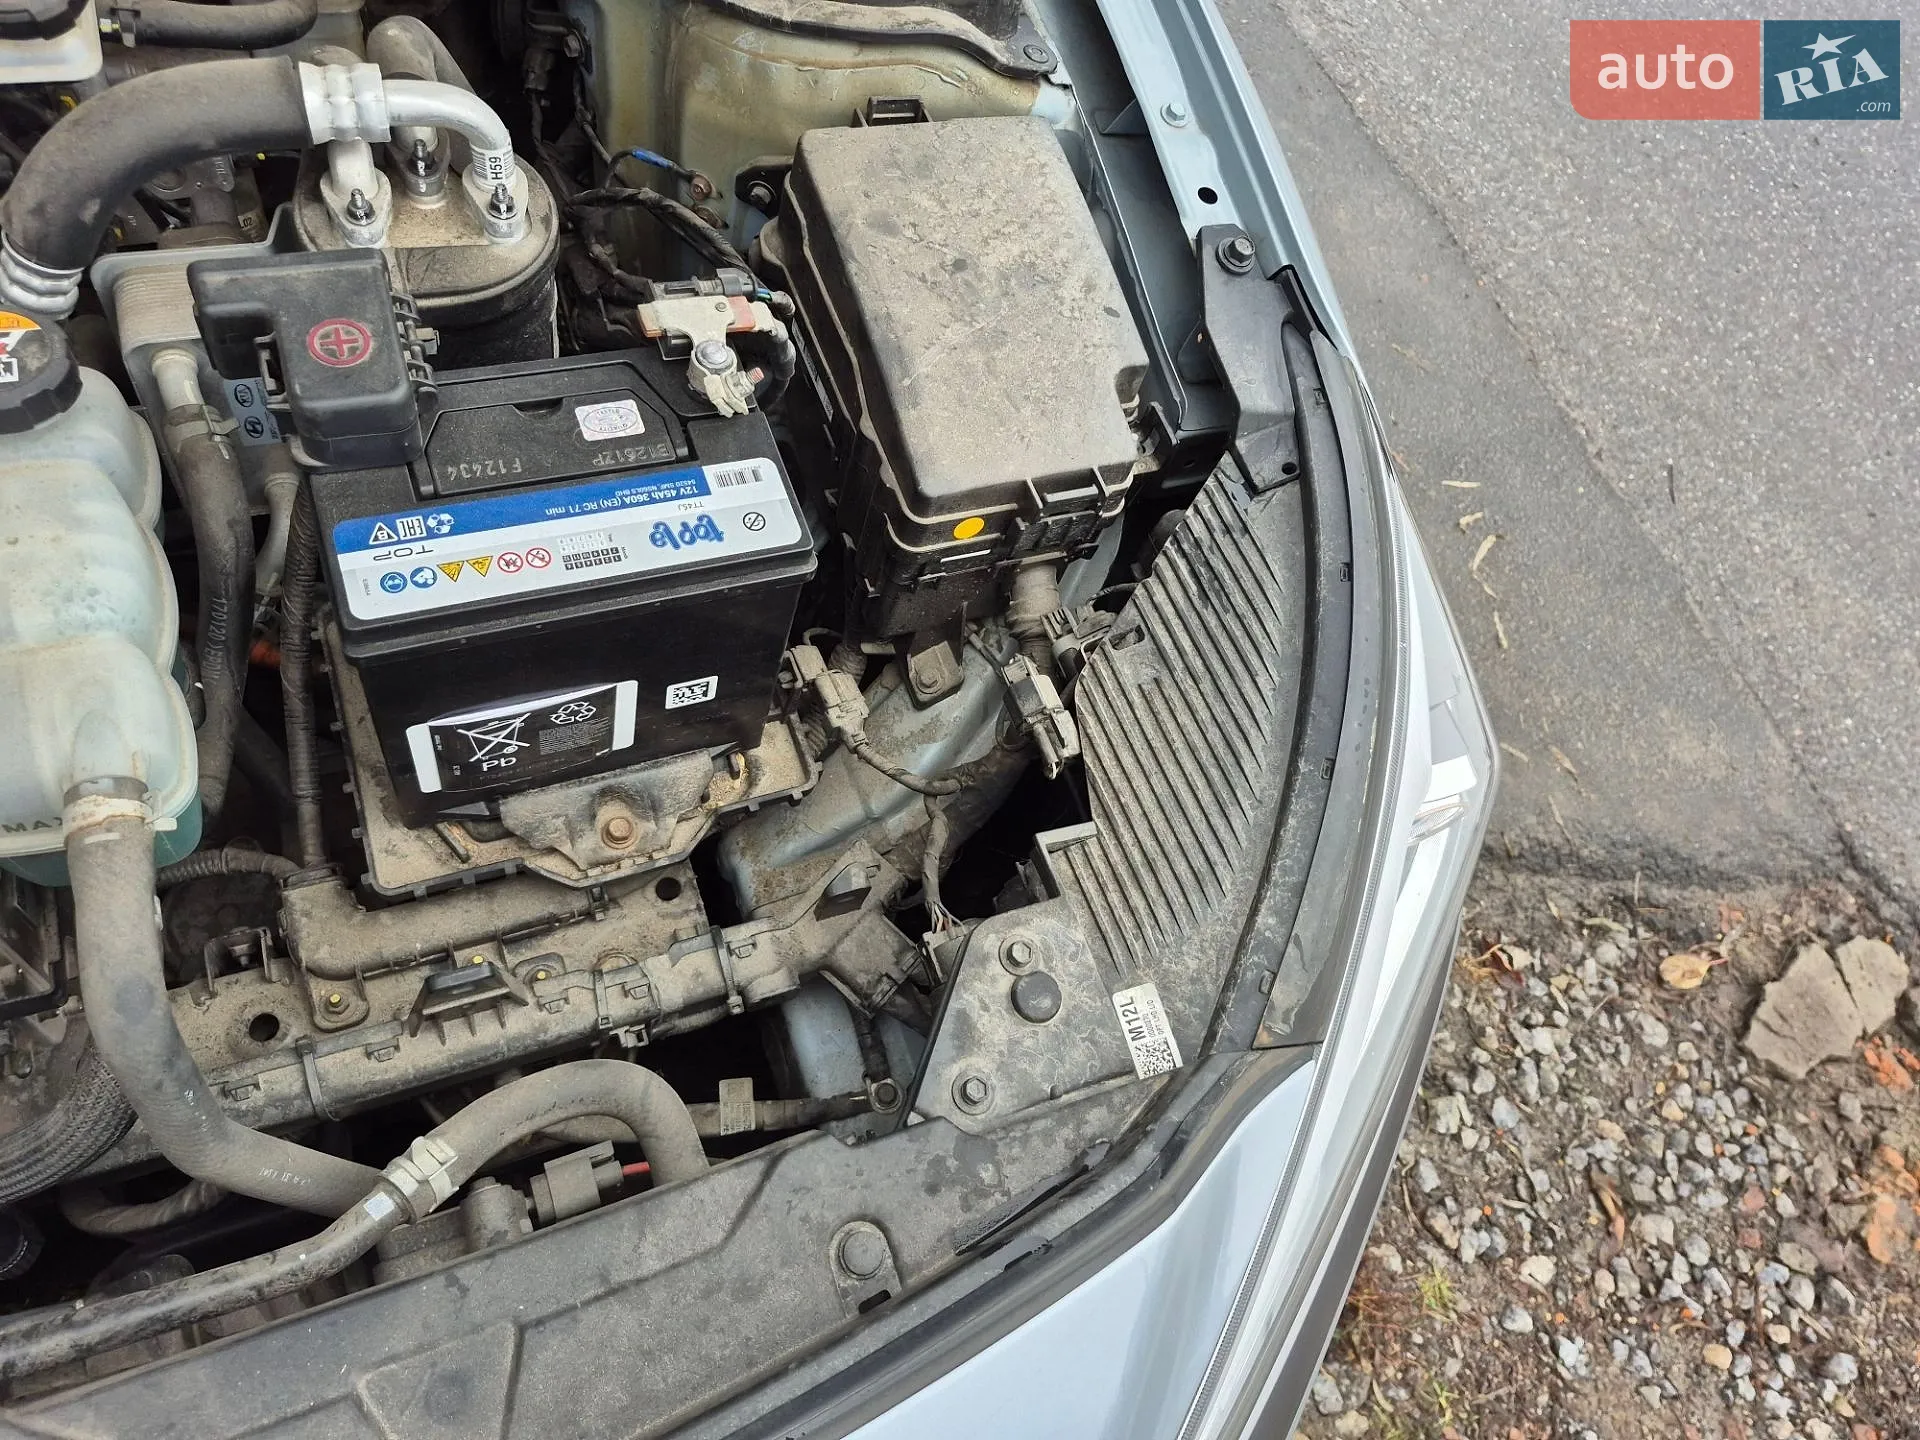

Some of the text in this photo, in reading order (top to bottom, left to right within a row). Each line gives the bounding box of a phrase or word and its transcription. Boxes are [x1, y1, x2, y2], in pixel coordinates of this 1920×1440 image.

[488, 156, 503, 180] H59
[599, 423, 629, 432] QUALITY
[546, 486, 699, 516] 12V 45Ah 360A (EN) RC 71 min
[678, 501, 704, 511] TT45J
[399, 517, 425, 538] EAC
[373, 544, 434, 561] TOP
[482, 756, 517, 772] Pb
[1120, 996, 1147, 1042] M12L
